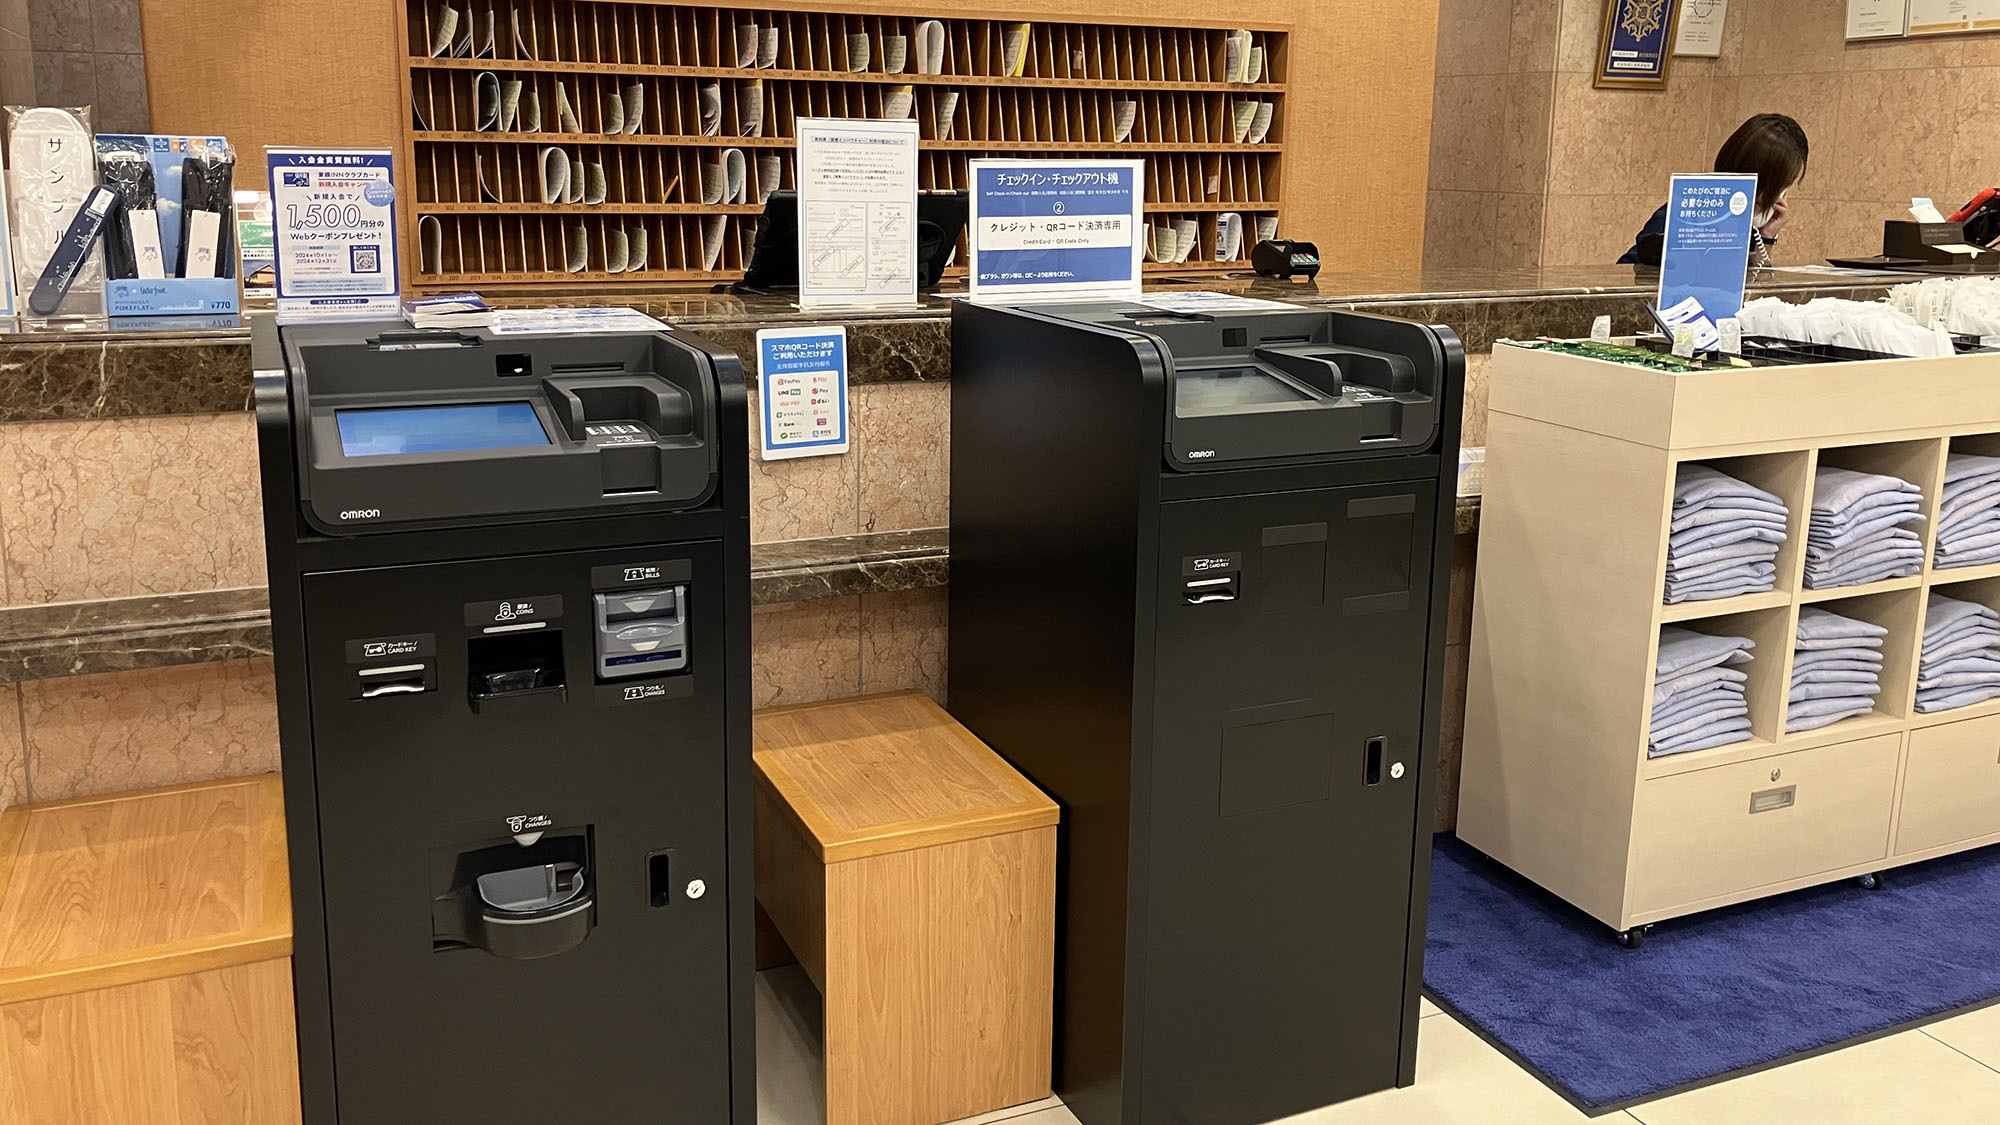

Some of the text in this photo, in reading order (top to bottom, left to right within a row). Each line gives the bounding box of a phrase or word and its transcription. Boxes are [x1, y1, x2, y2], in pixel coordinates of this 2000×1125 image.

[997, 173, 1119, 186] チェックイン・チェックアウト機
[48, 138, 66, 245] サンプル
[1681, 198, 1724, 208] 必要な分のみ
[1680, 210, 1717, 218] お持ちください
[990, 221, 1121, 232] クレジット・QRコード決済専用
[340, 509, 381, 520] OMRON
